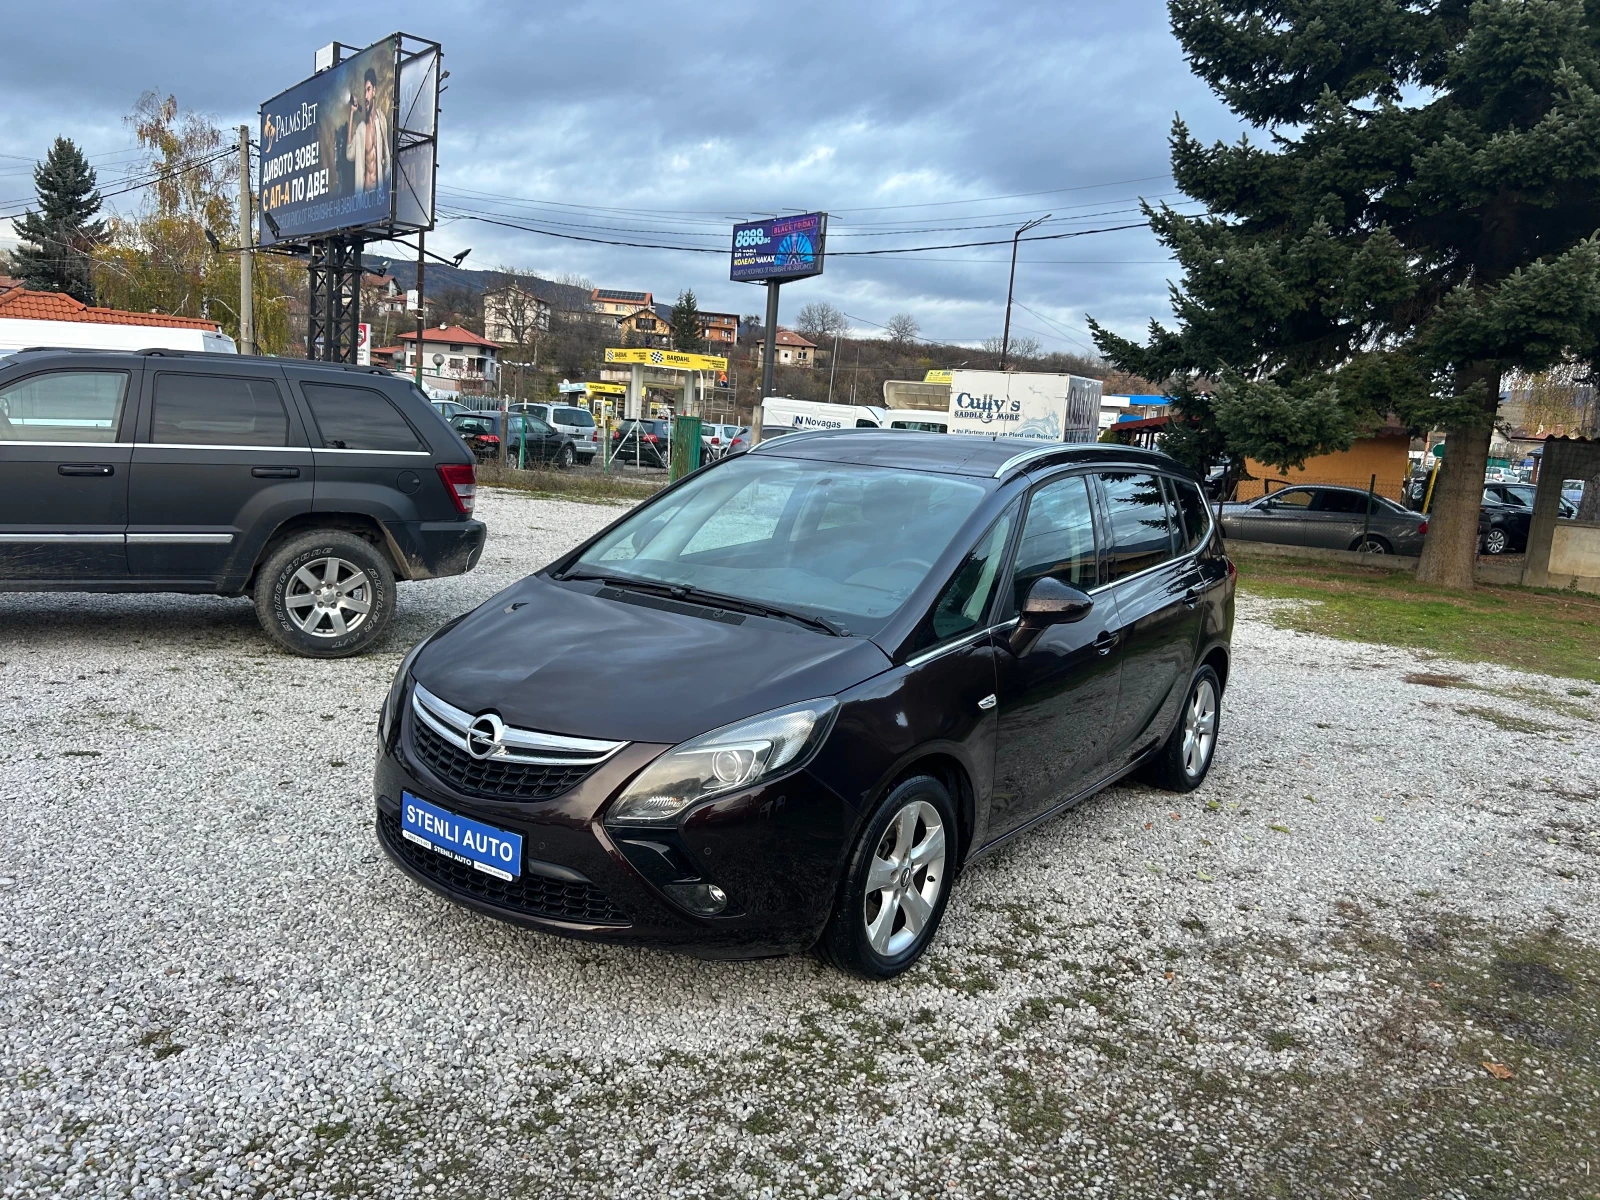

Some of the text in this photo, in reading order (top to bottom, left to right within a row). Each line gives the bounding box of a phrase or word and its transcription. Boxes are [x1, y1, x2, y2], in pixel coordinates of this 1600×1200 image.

[276, 102, 318, 142] PALMS BET
[262, 141, 319, 186] ДИВОТО ЗОВЕ!
[262, 168, 328, 212] С АП-А ПО ДВЕ!
[774, 220, 814, 234] BLACK FRIDAY
[666, 354, 690, 363] BARDAHL
[805, 416, 841, 429] Novagas
[954, 410, 984, 419] SADDLE
[275, 548, 333, 632] BRIDGESTONE
[364, 568, 384, 632] DUELER
[406, 804, 458, 843] STENLI
[462, 830, 513, 862] AUTO
[434, 845, 472, 866] STENLI AUTO
